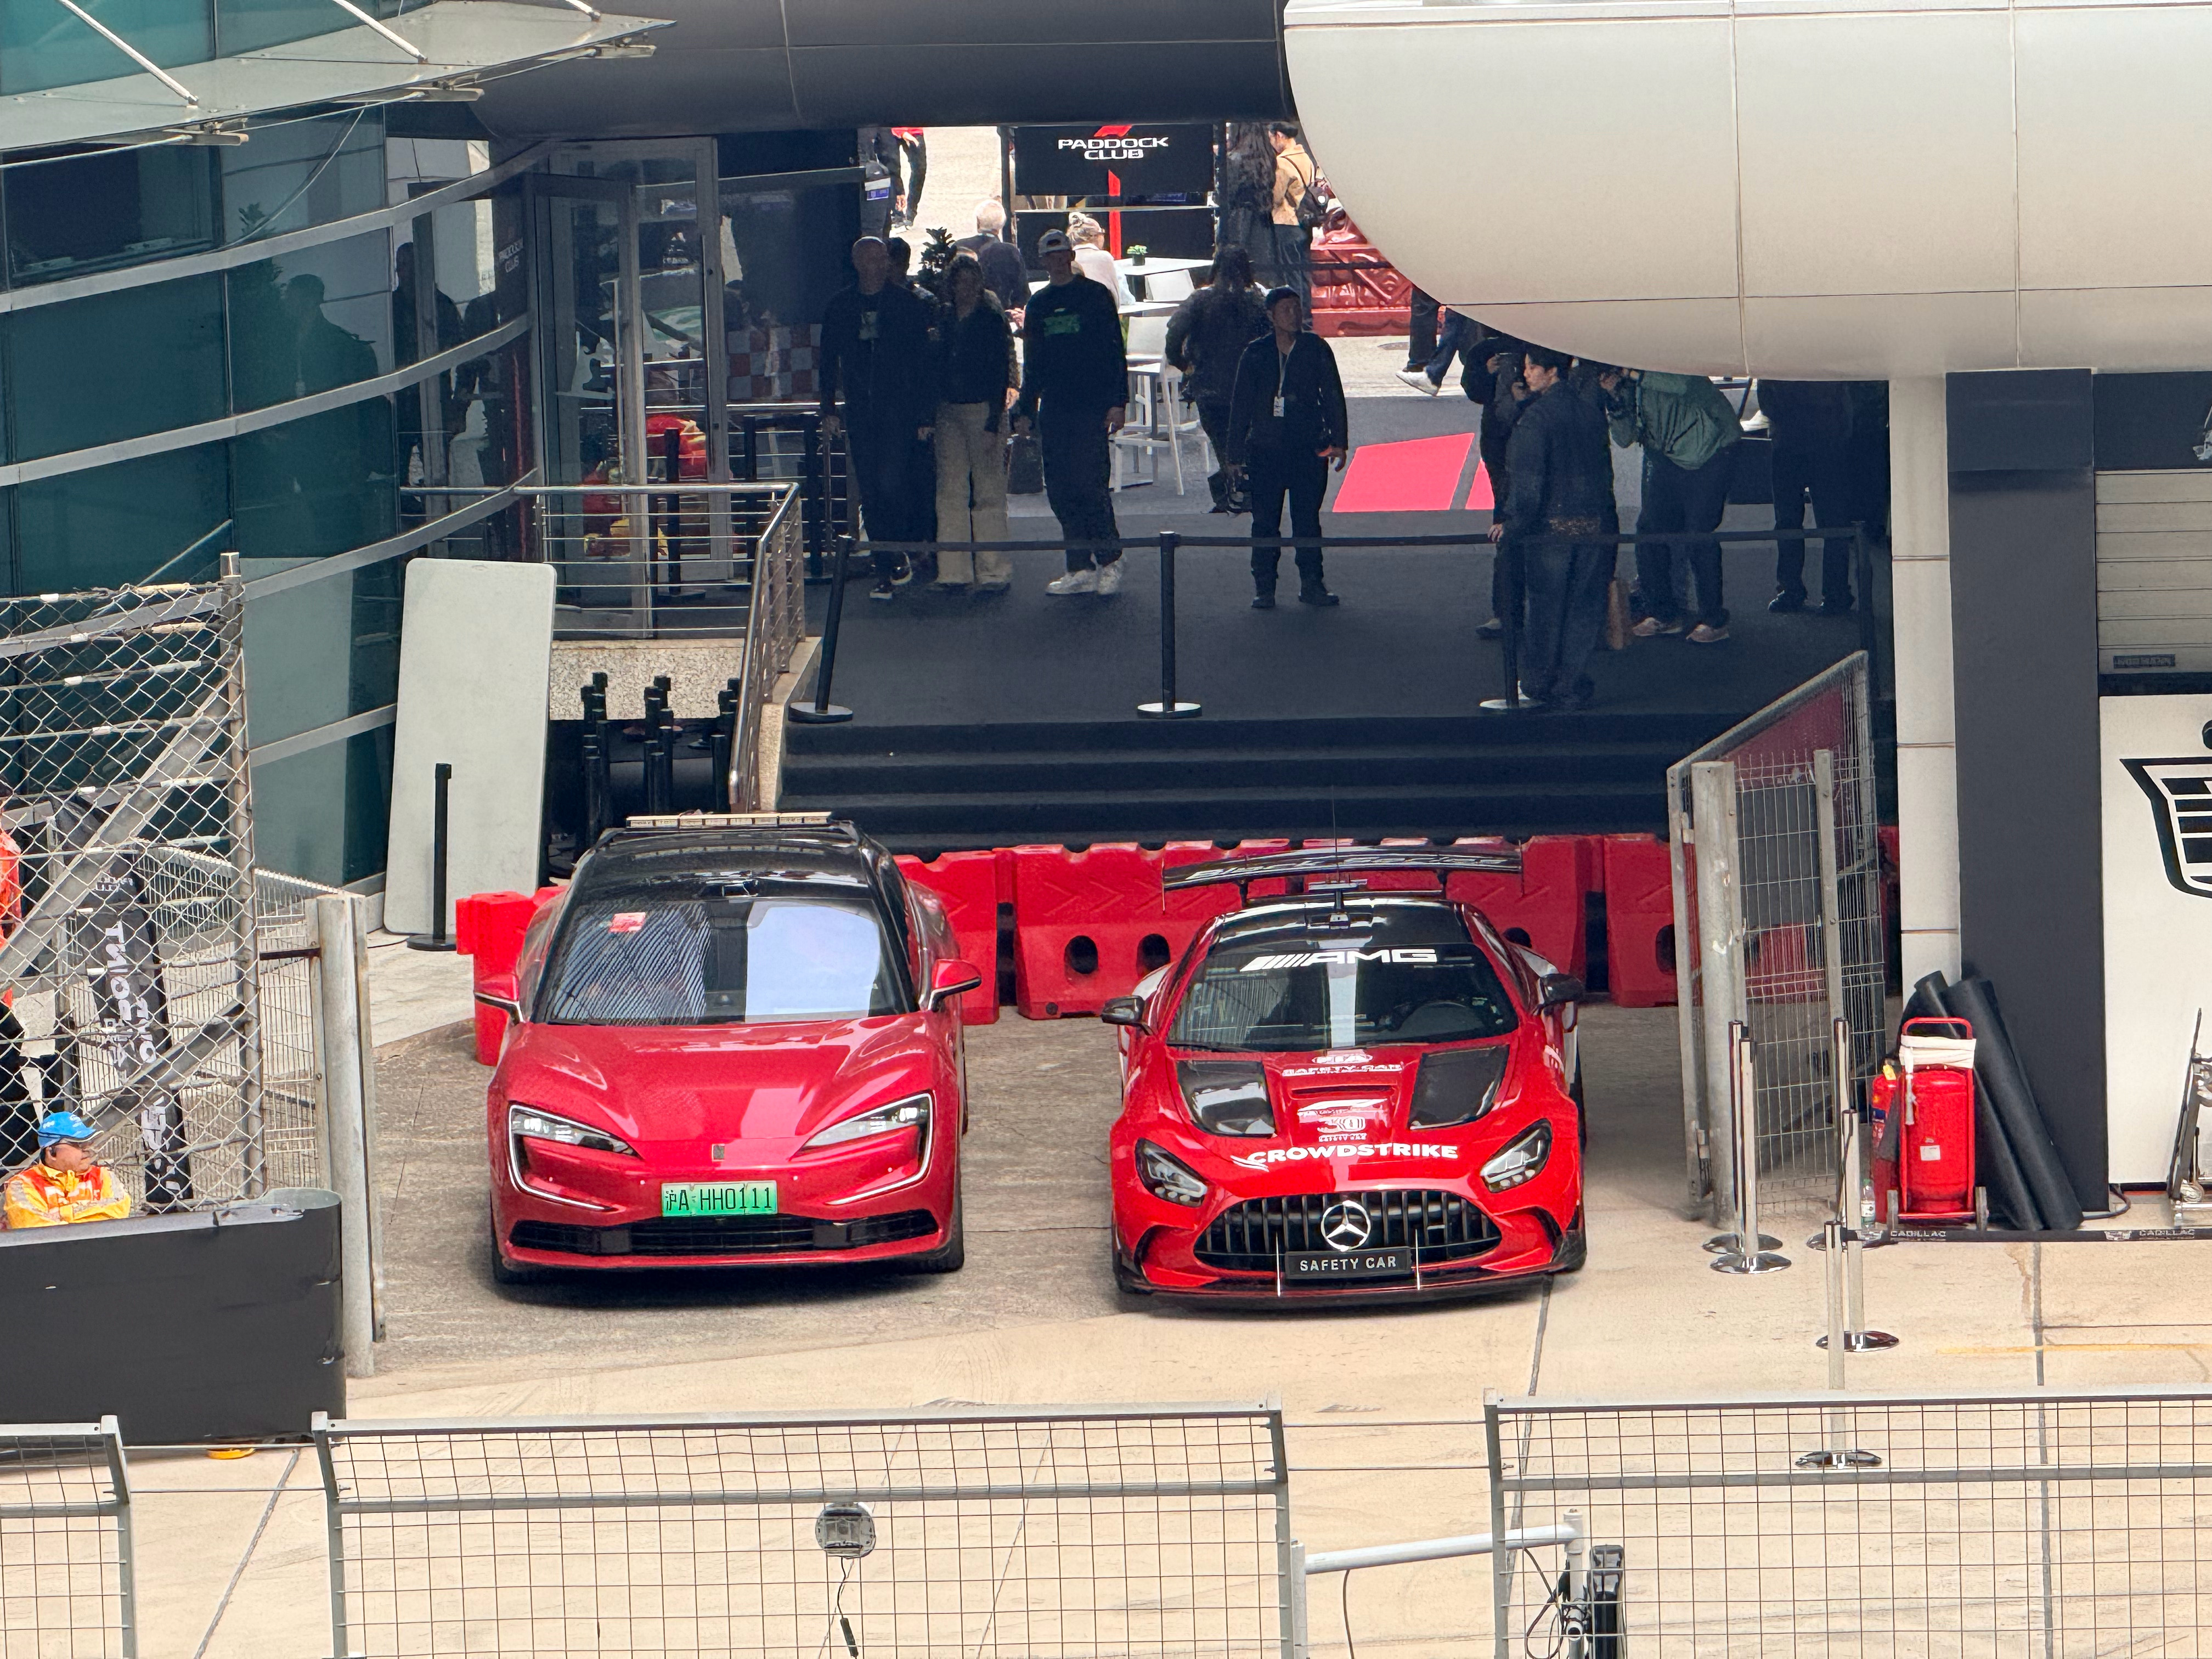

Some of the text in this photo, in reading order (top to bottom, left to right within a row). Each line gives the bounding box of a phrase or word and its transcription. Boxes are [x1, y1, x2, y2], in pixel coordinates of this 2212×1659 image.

[1058, 137, 1169, 149] PADDOCK
[1084, 148, 1144, 160] CLUB
[1300, 949, 1437, 967] AMG
[1246, 1143, 1458, 1164] CROWDSTRIKE
[1300, 1256, 1397, 1271] SAFETY CAR
